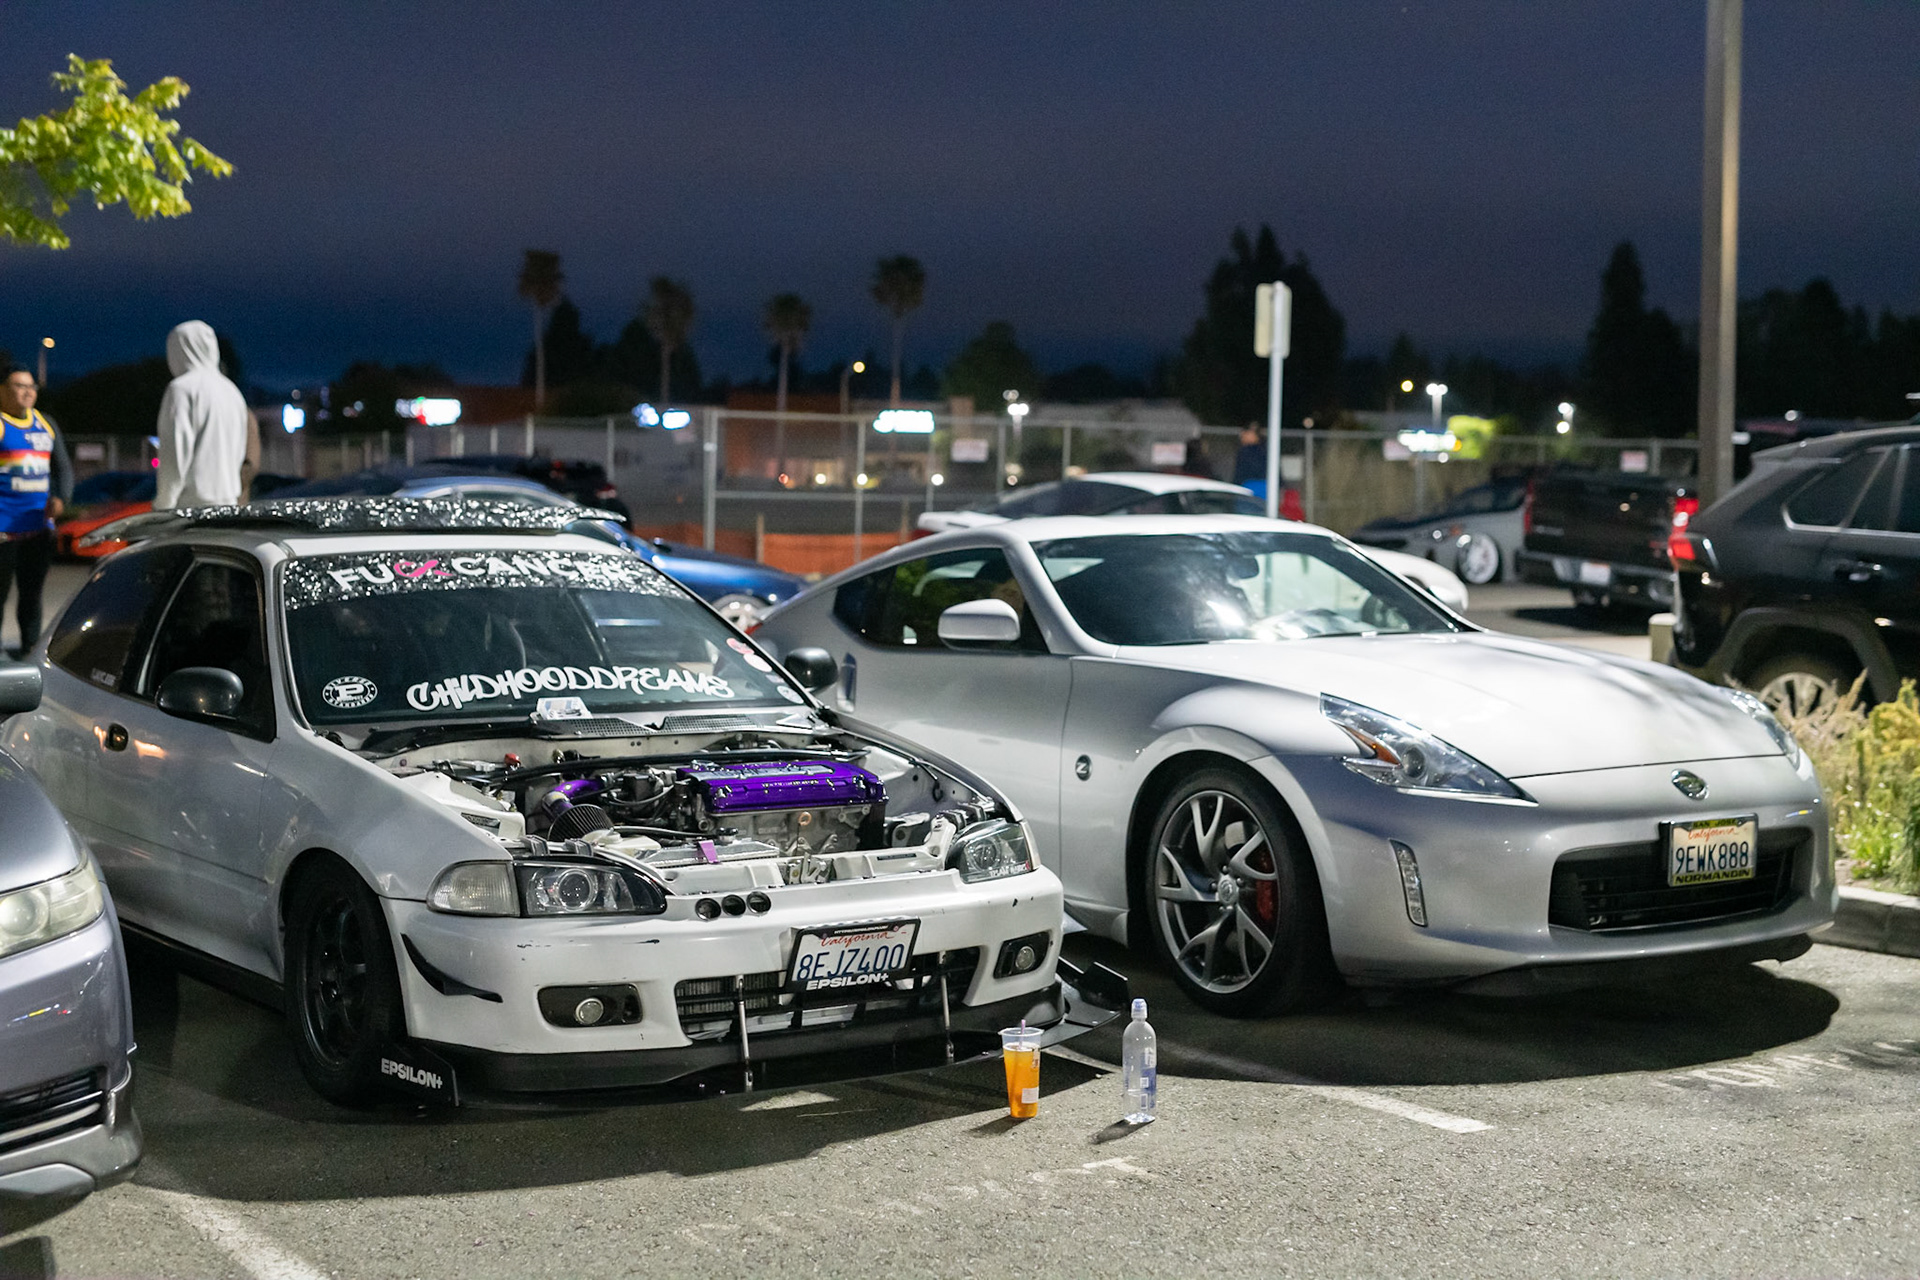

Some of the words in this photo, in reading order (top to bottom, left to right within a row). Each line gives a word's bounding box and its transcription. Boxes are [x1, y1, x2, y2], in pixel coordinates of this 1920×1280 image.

[451, 556, 635, 586] CANCER
[1675, 841, 1749, 874] 9EWK888
[1674, 868, 1750, 884] NORMANDIN
[820, 930, 895, 949] California
[796, 943, 905, 981] 8EJZ400
[805, 972, 889, 991] EPSILON+
[381, 1057, 443, 1090] EPSILON+
